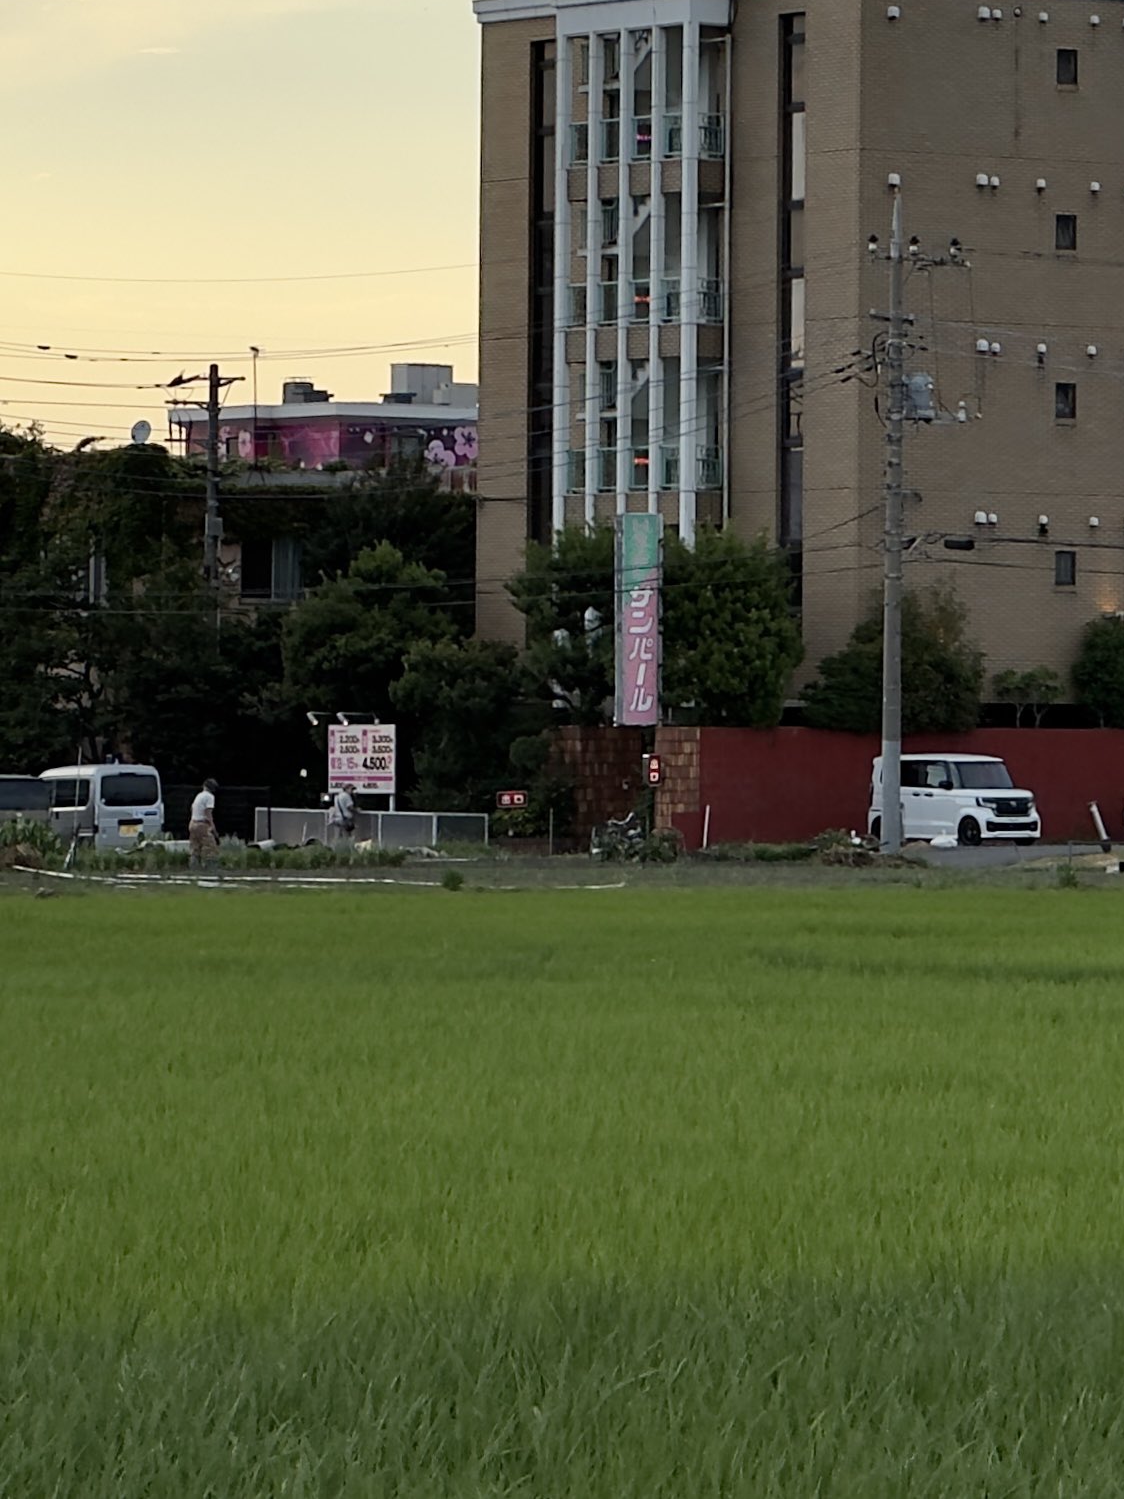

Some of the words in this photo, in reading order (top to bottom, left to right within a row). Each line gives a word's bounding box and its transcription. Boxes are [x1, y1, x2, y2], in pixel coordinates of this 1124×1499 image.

[629, 585, 654, 712] サンパール
